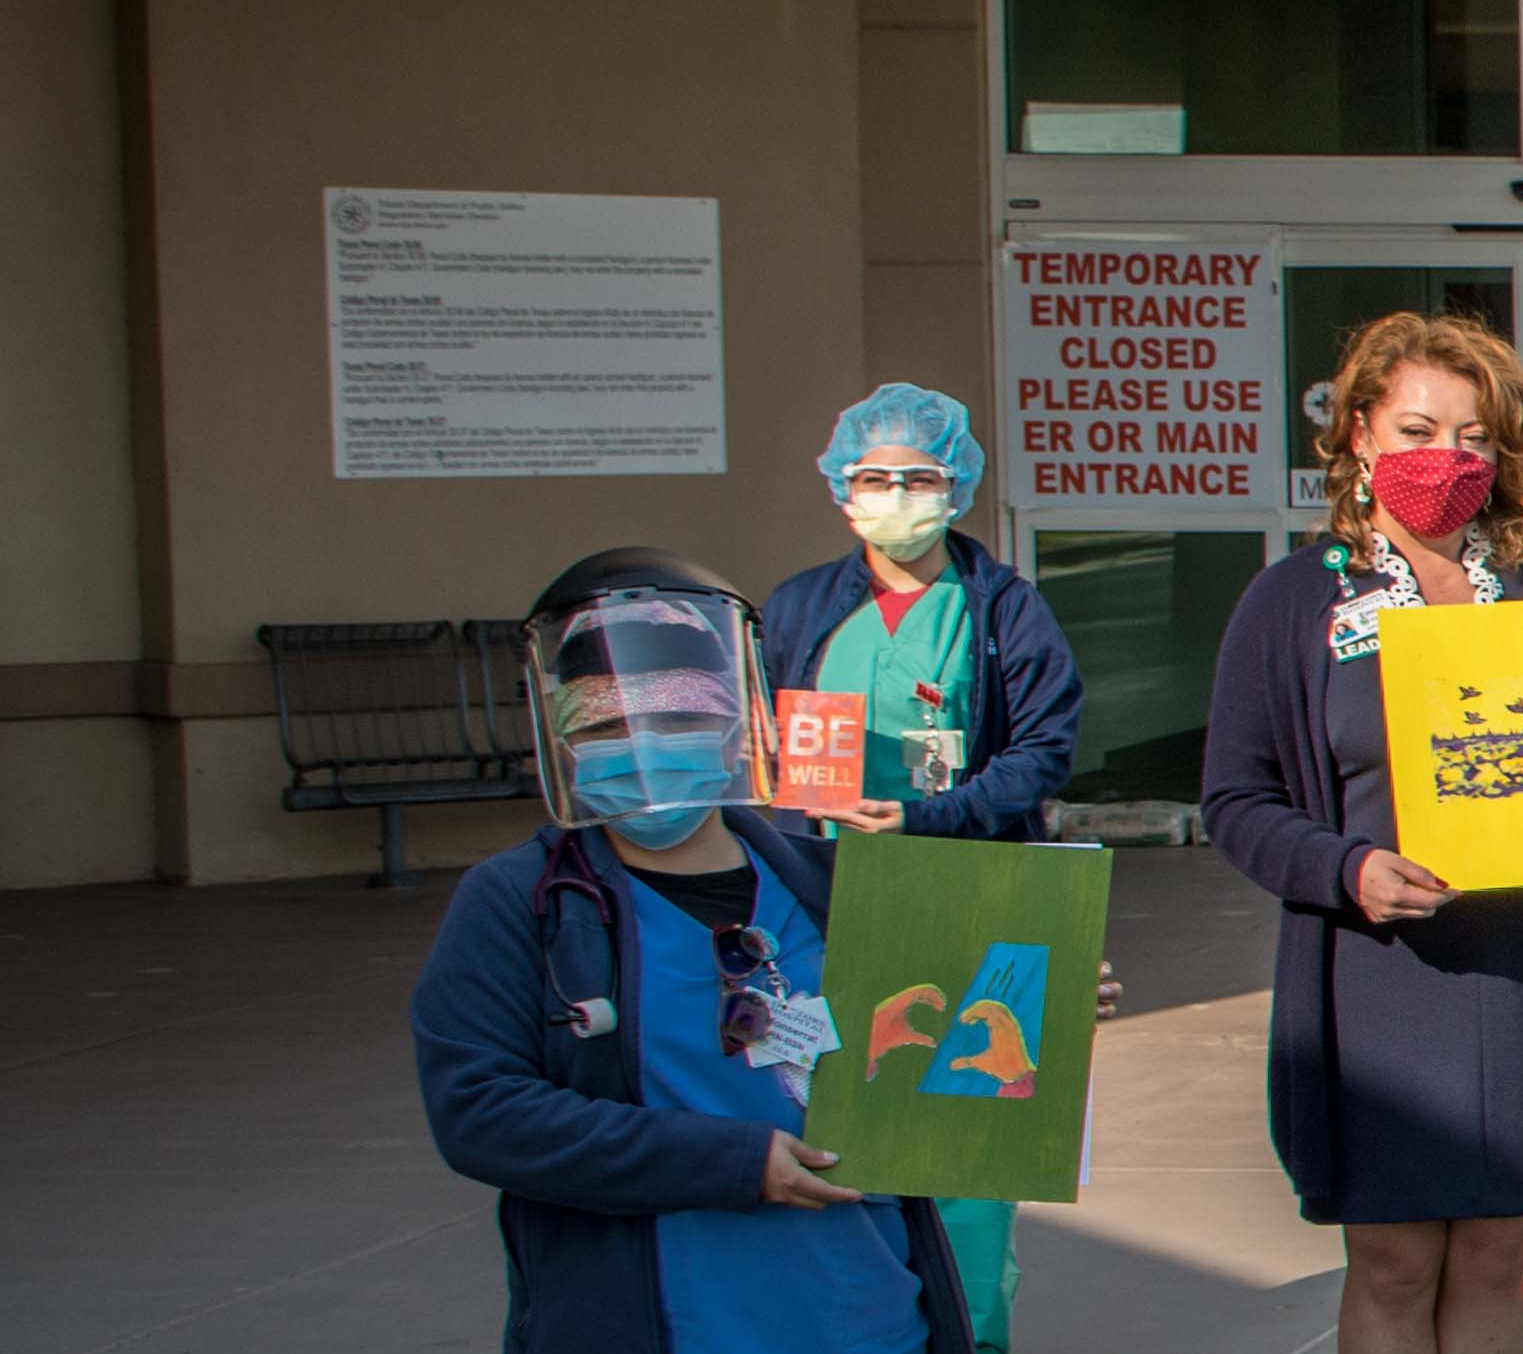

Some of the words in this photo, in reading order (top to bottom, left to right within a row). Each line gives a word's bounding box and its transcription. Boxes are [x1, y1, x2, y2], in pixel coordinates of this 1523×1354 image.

[1013, 252, 1261, 286] TEMPORARY
[1030, 294, 1246, 329] ENTRANCE
[1059, 336, 1217, 370] CLOSED
[1018, 378, 1169, 412] PLEASE
[1182, 380, 1262, 413] USE
[1023, 420, 1074, 453] ER
[1087, 420, 1143, 454] OR
[1156, 421, 1258, 455] MAIN
[1034, 462, 1250, 496] ENTRANCE
[1335, 638, 1380, 659] LEAD
[787, 713, 859, 758] BE
[787, 764, 856, 788] WELL
